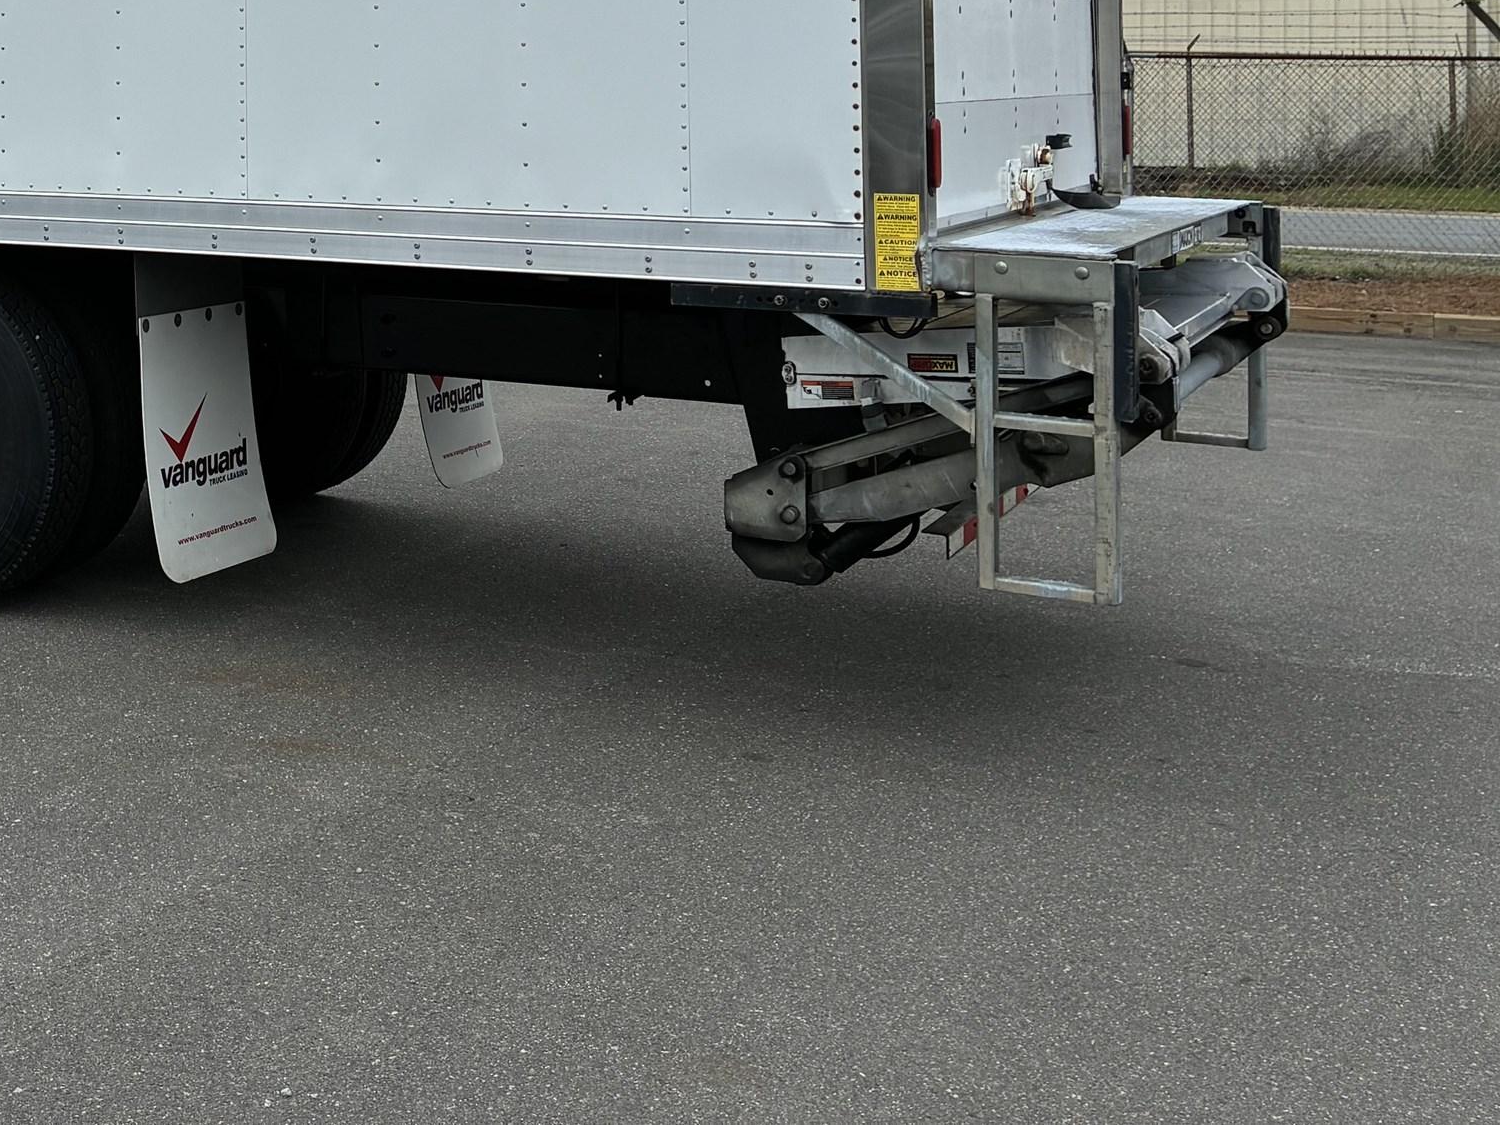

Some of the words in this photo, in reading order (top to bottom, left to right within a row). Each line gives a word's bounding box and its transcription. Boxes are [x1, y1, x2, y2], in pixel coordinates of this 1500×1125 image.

[426, 379, 483, 413] vanguard
[160, 437, 248, 489] vanguard
[209, 474, 227, 486] TRUCK
[227, 468, 249, 481] LEASING
[178, 515, 258, 545] www.vanguardtrucks.com
